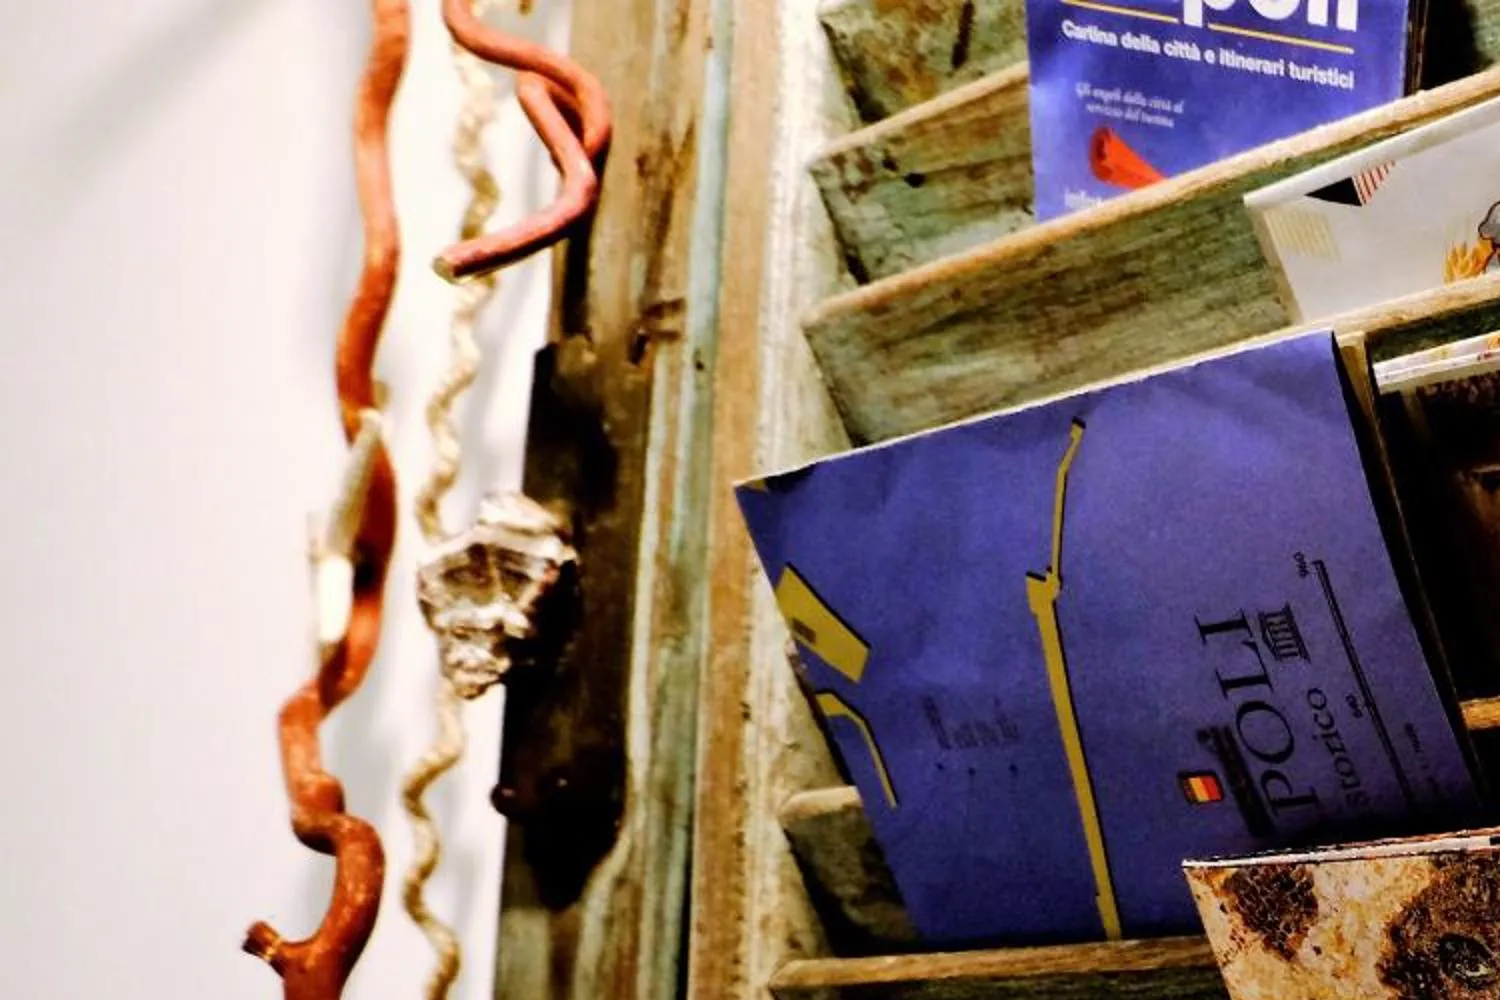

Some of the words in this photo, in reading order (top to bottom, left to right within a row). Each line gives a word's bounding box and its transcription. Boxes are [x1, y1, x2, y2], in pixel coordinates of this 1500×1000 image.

[1061, 19, 1118, 48] Cartina
[1122, 33, 1160, 55] della
[1164, 39, 1202, 62] città
[1204, 49, 1217, 63] e
[1289, 63, 1354, 90] turistici
